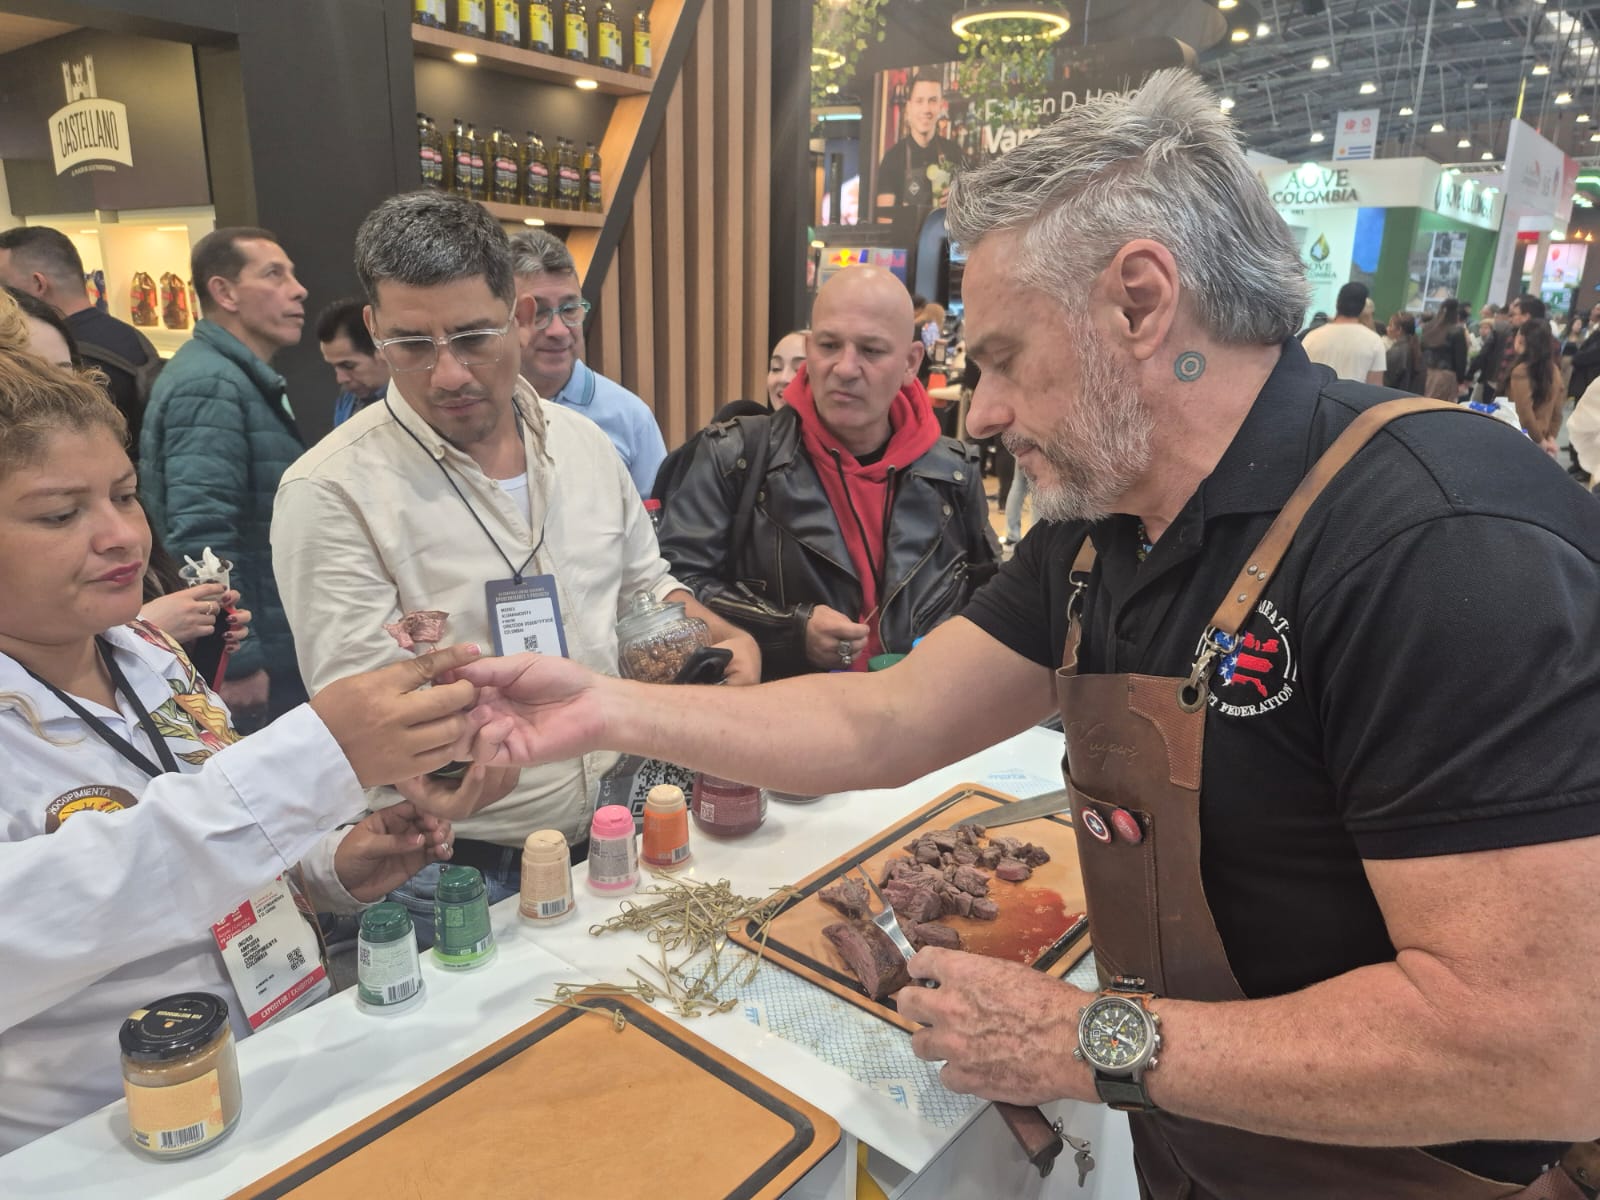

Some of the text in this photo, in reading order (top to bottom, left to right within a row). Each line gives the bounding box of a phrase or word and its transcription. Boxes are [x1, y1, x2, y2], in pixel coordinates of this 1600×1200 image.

[58, 109, 119, 159] CASTELLANO
[1272, 189, 1358, 204] COLOMBIA
[1219, 683, 1293, 717] FEDERATION
